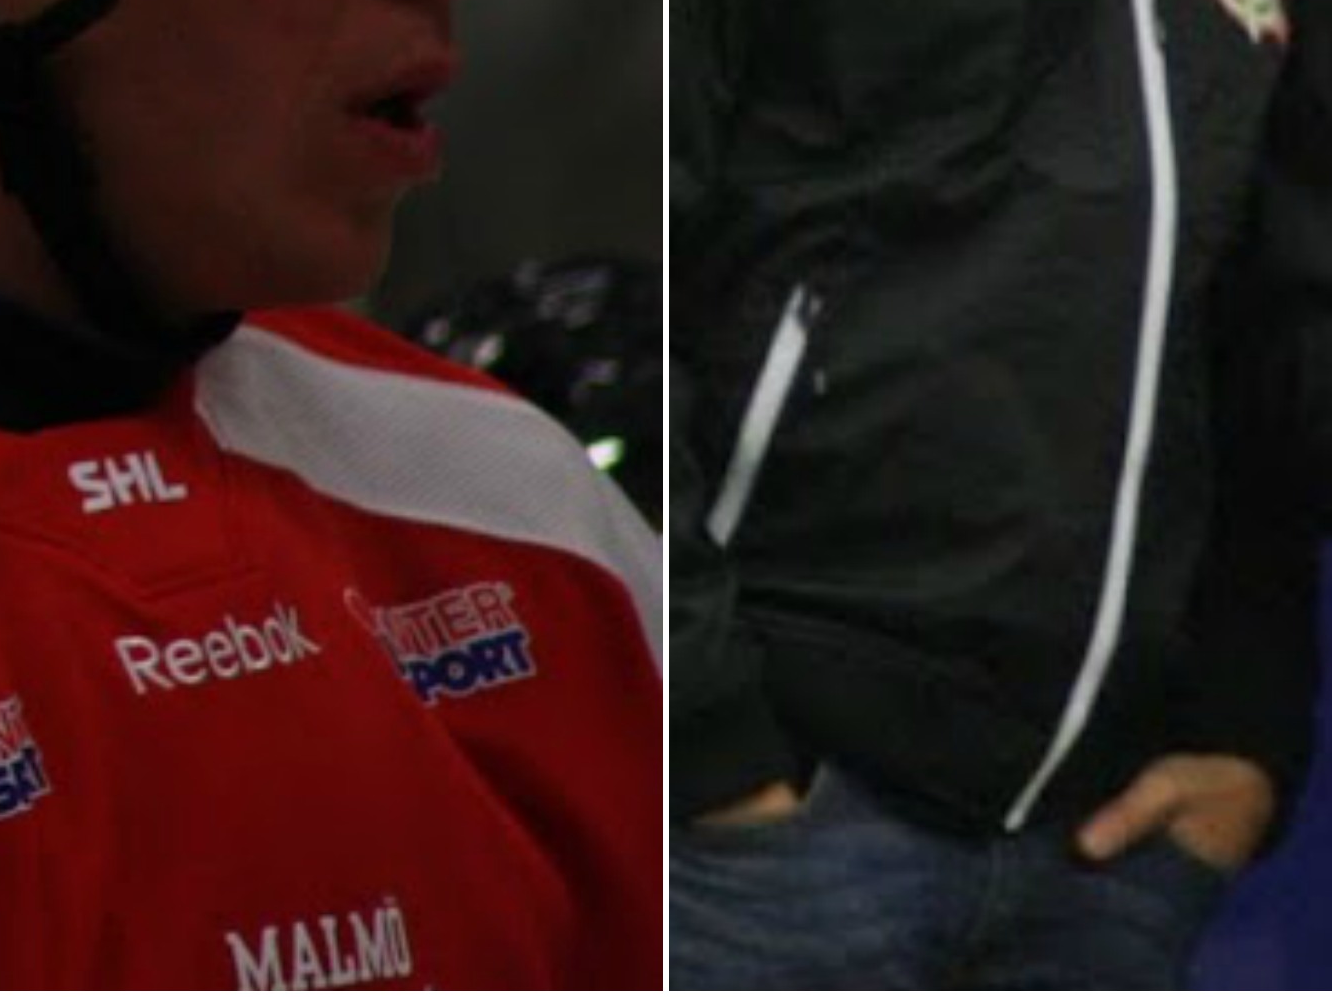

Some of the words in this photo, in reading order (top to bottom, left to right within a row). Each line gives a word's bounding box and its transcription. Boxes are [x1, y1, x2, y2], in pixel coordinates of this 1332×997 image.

[69, 450, 188, 514] SHL
[115, 601, 322, 695] Reebok
[400, 625, 536, 708] PORT
[225, 897, 412, 991] MALMÖ
